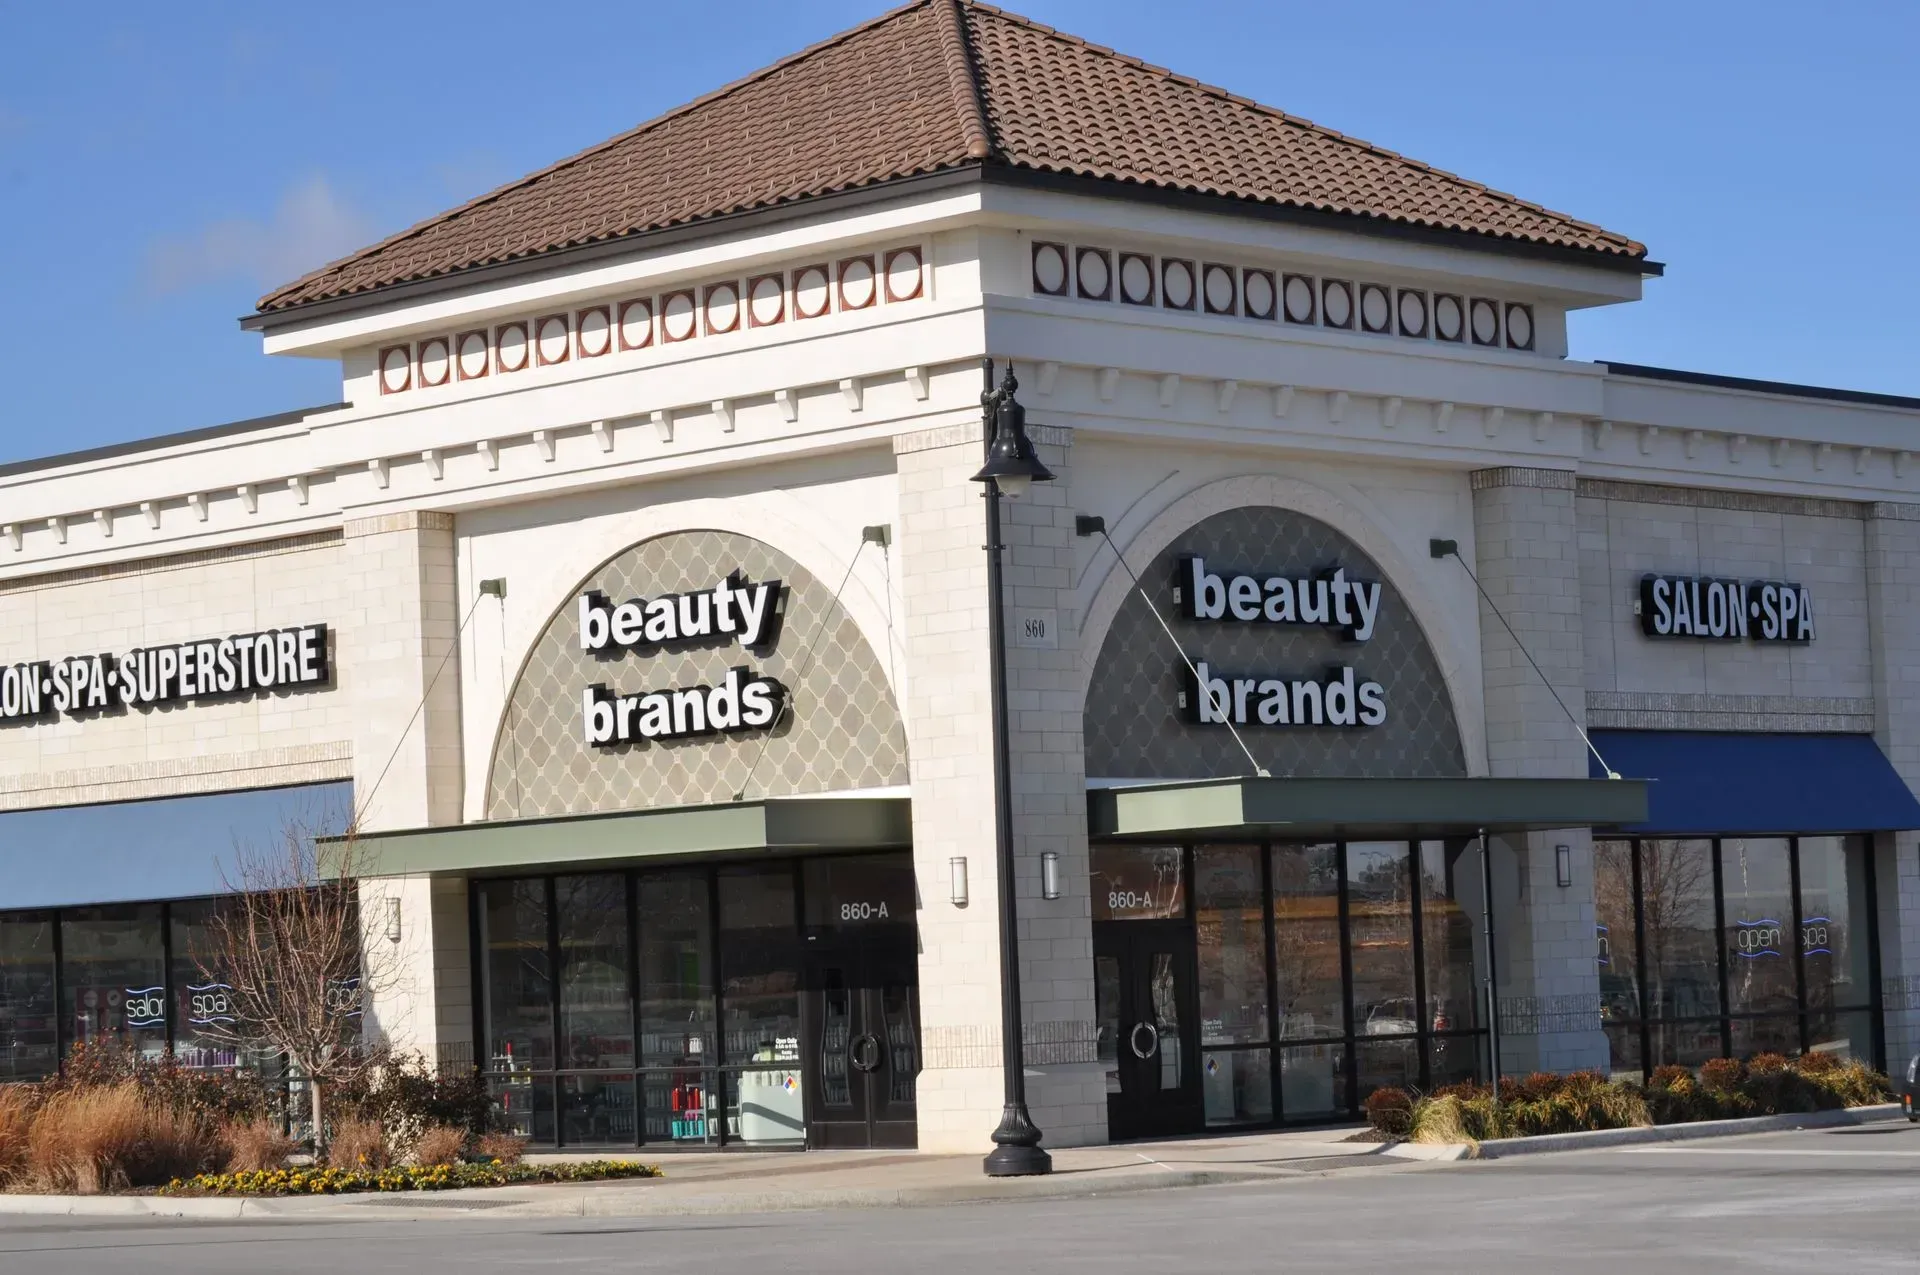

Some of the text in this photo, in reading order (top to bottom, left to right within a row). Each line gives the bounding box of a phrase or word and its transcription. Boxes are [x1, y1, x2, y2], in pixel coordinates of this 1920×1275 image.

[579, 577, 768, 649] beauty
[1025, 619, 1045, 638] 860
[1192, 557, 1381, 641] beauty
[1653, 578, 1816, 640] SALON SPA
[0, 628, 319, 717] ON SPA SUPERSTORE
[1197, 662, 1387, 726] brands
[582, 670, 774, 743] brands
[841, 901, 889, 920] 860-A
[1108, 891, 1153, 908] 860-A
[1738, 928, 1781, 953] open
[192, 993, 227, 1020] spa
